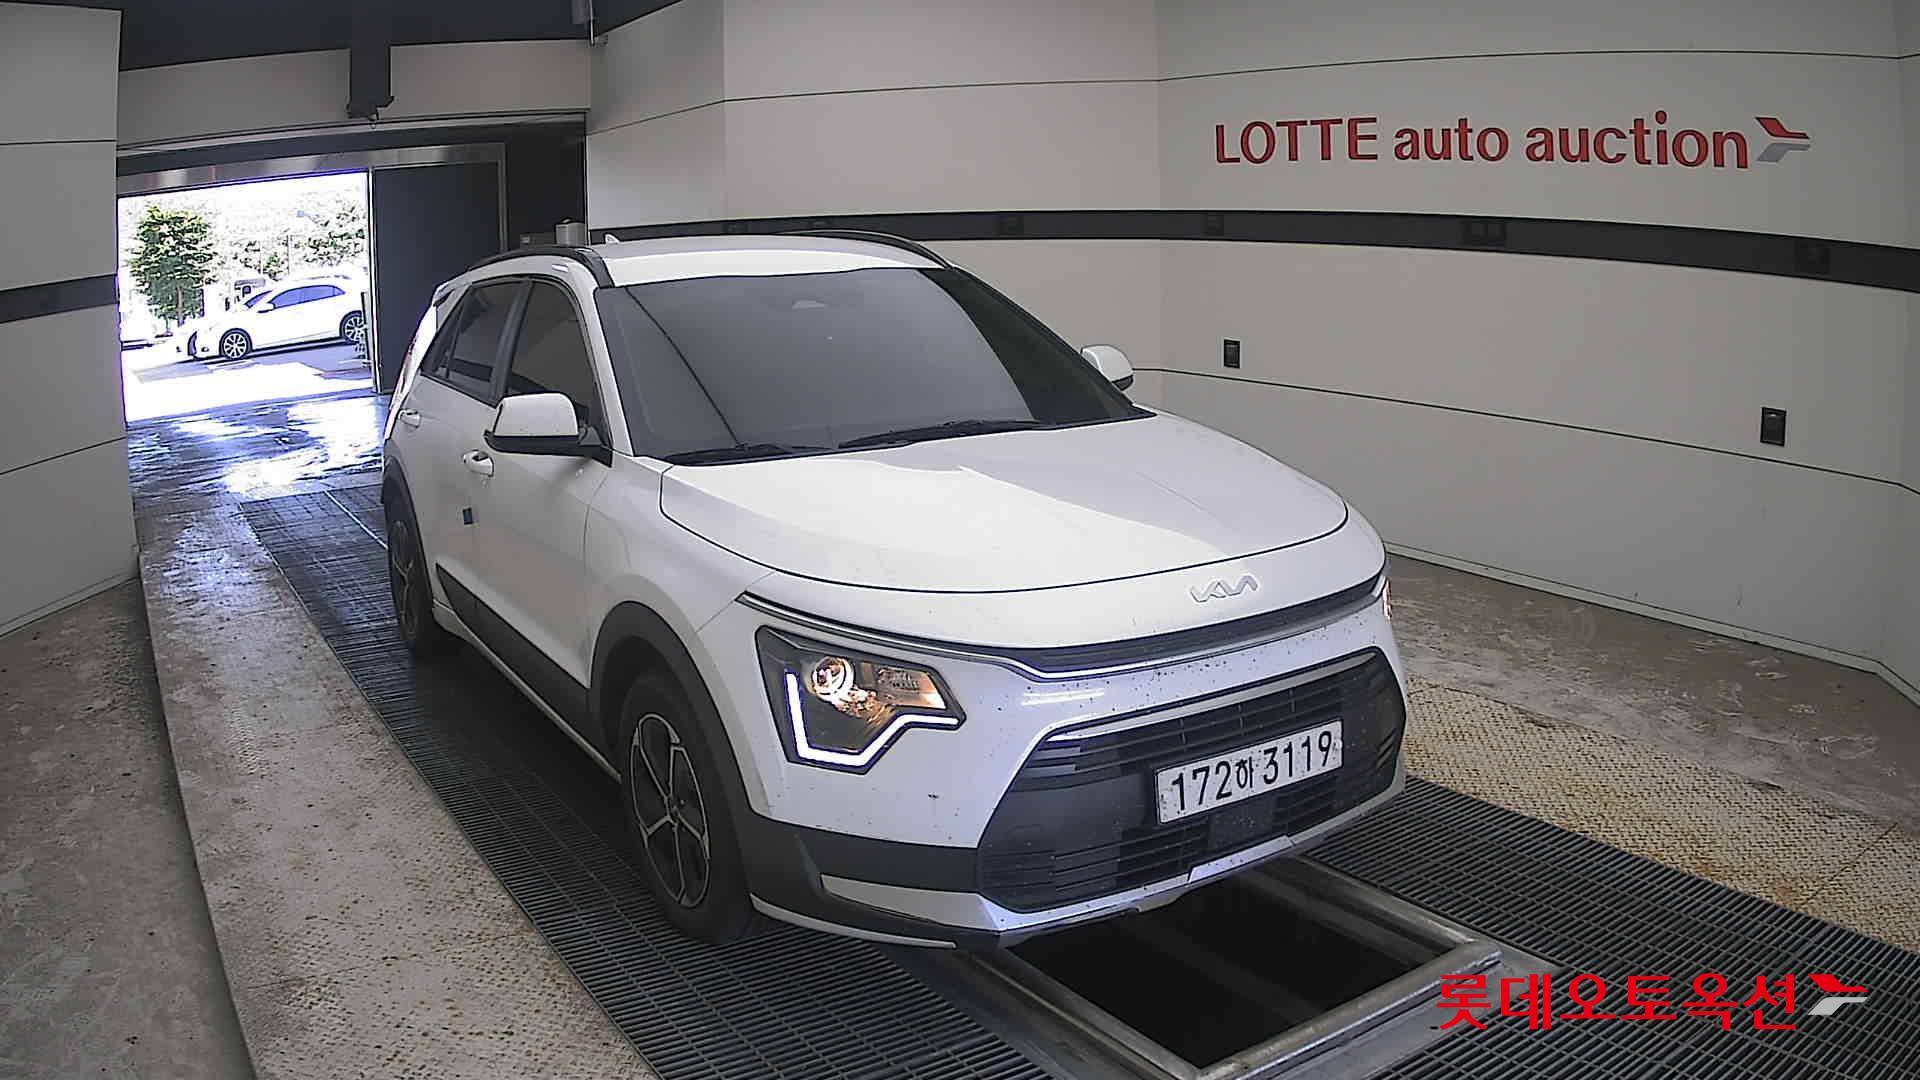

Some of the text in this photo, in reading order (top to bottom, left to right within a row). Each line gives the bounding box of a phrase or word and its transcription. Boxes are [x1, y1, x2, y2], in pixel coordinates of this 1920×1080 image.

[1215, 111, 1749, 168] LOTTE auto auction
